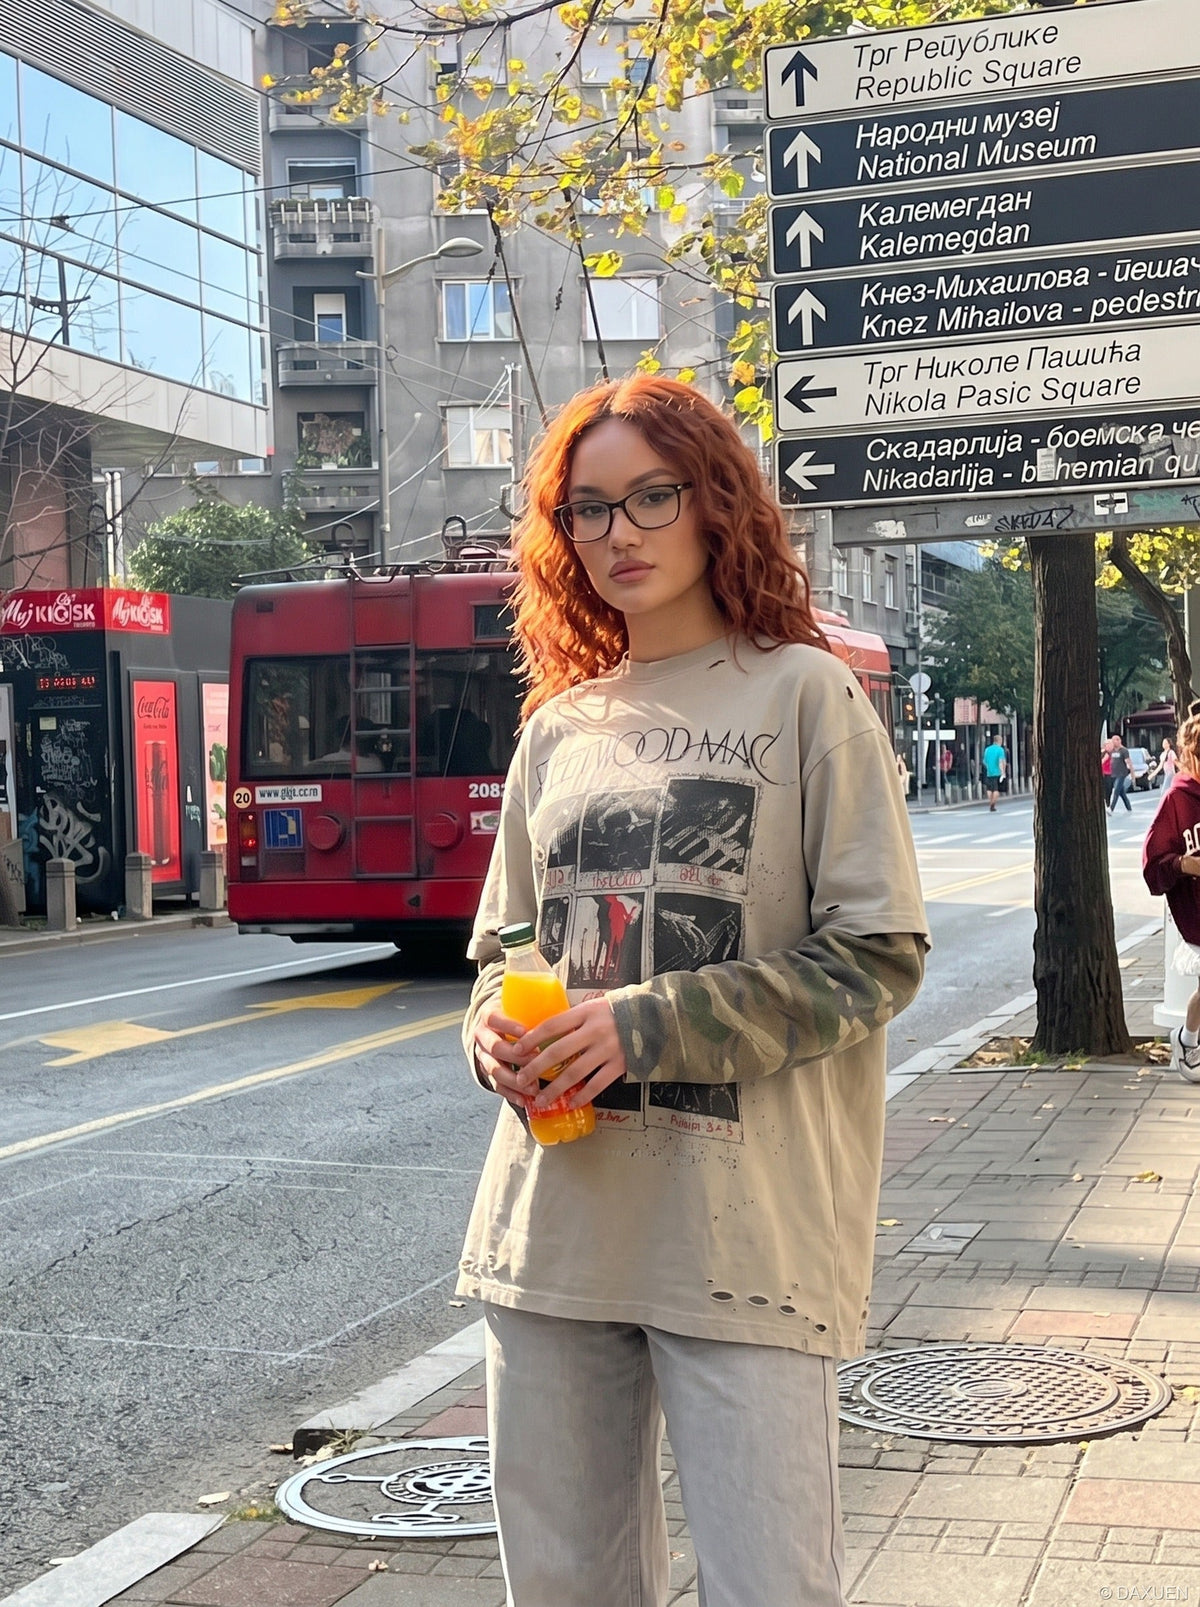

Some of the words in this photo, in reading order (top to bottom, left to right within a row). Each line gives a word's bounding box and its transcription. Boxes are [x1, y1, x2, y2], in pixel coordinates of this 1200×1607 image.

[853, 43, 897, 71] Трг
[905, 24, 1059, 60] Републике
[855, 66, 973, 101] Republic
[983, 55, 1082, 85] Square
[856, 117, 976, 151] Народни
[982, 101, 1062, 139] музеј
[857, 141, 967, 181] National
[977, 132, 1096, 168] Museum
[858, 190, 1033, 228] Калемегдан
[859, 221, 1031, 260] Kalemegdan
[860, 266, 1090, 307] Кнез-Михаилова
[861, 313, 928, 340] Knez
[936, 298, 1063, 331] Mihailova
[864, 359, 908, 390] Трг
[914, 351, 1020, 382] Николе
[1026, 340, 1142, 371] Пашића
[865, 386, 946, 417] Nikola
[957, 379, 1032, 409] Pasic
[1041, 374, 1142, 406] Square
[866, 429, 1023, 463] Скадарлија
[1047, 421, 1165, 449] боемска
[862, 460, 994, 494] Nikadarlija
[1021, 452, 1154, 483] bhemian
[235, 792, 250, 804] 20
